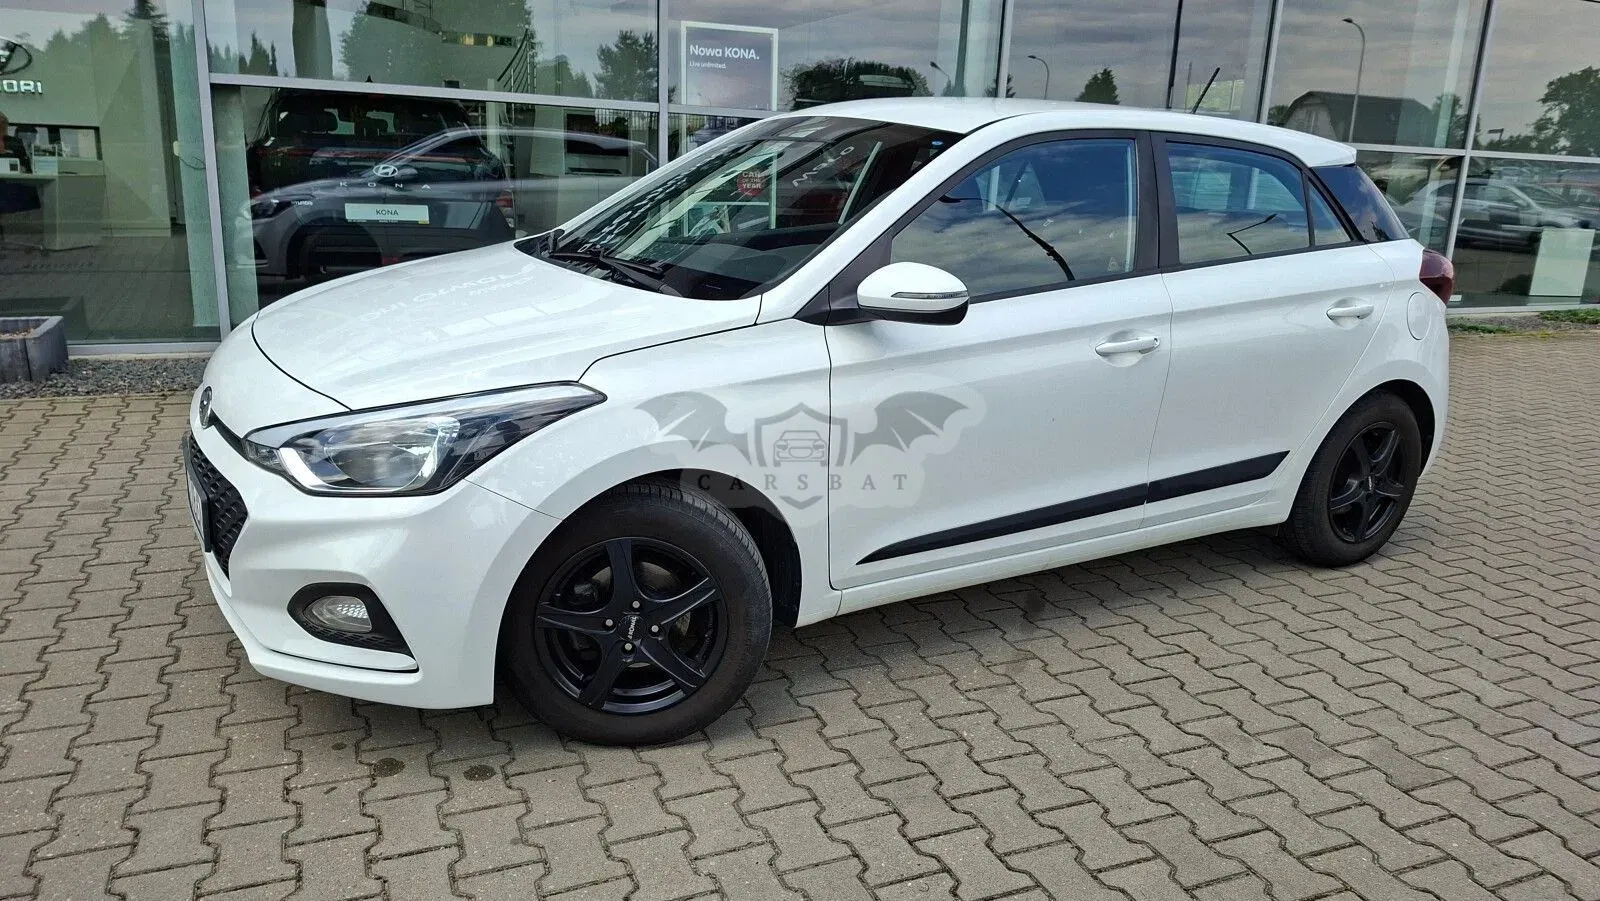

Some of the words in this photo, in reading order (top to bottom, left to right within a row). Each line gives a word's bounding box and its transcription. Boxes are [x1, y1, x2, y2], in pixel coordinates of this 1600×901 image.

[689, 44, 723, 57] Nowa
[724, 46, 760, 60] KONA.
[0, 79, 43, 94] ORI
[375, 208, 399, 216] KONA
